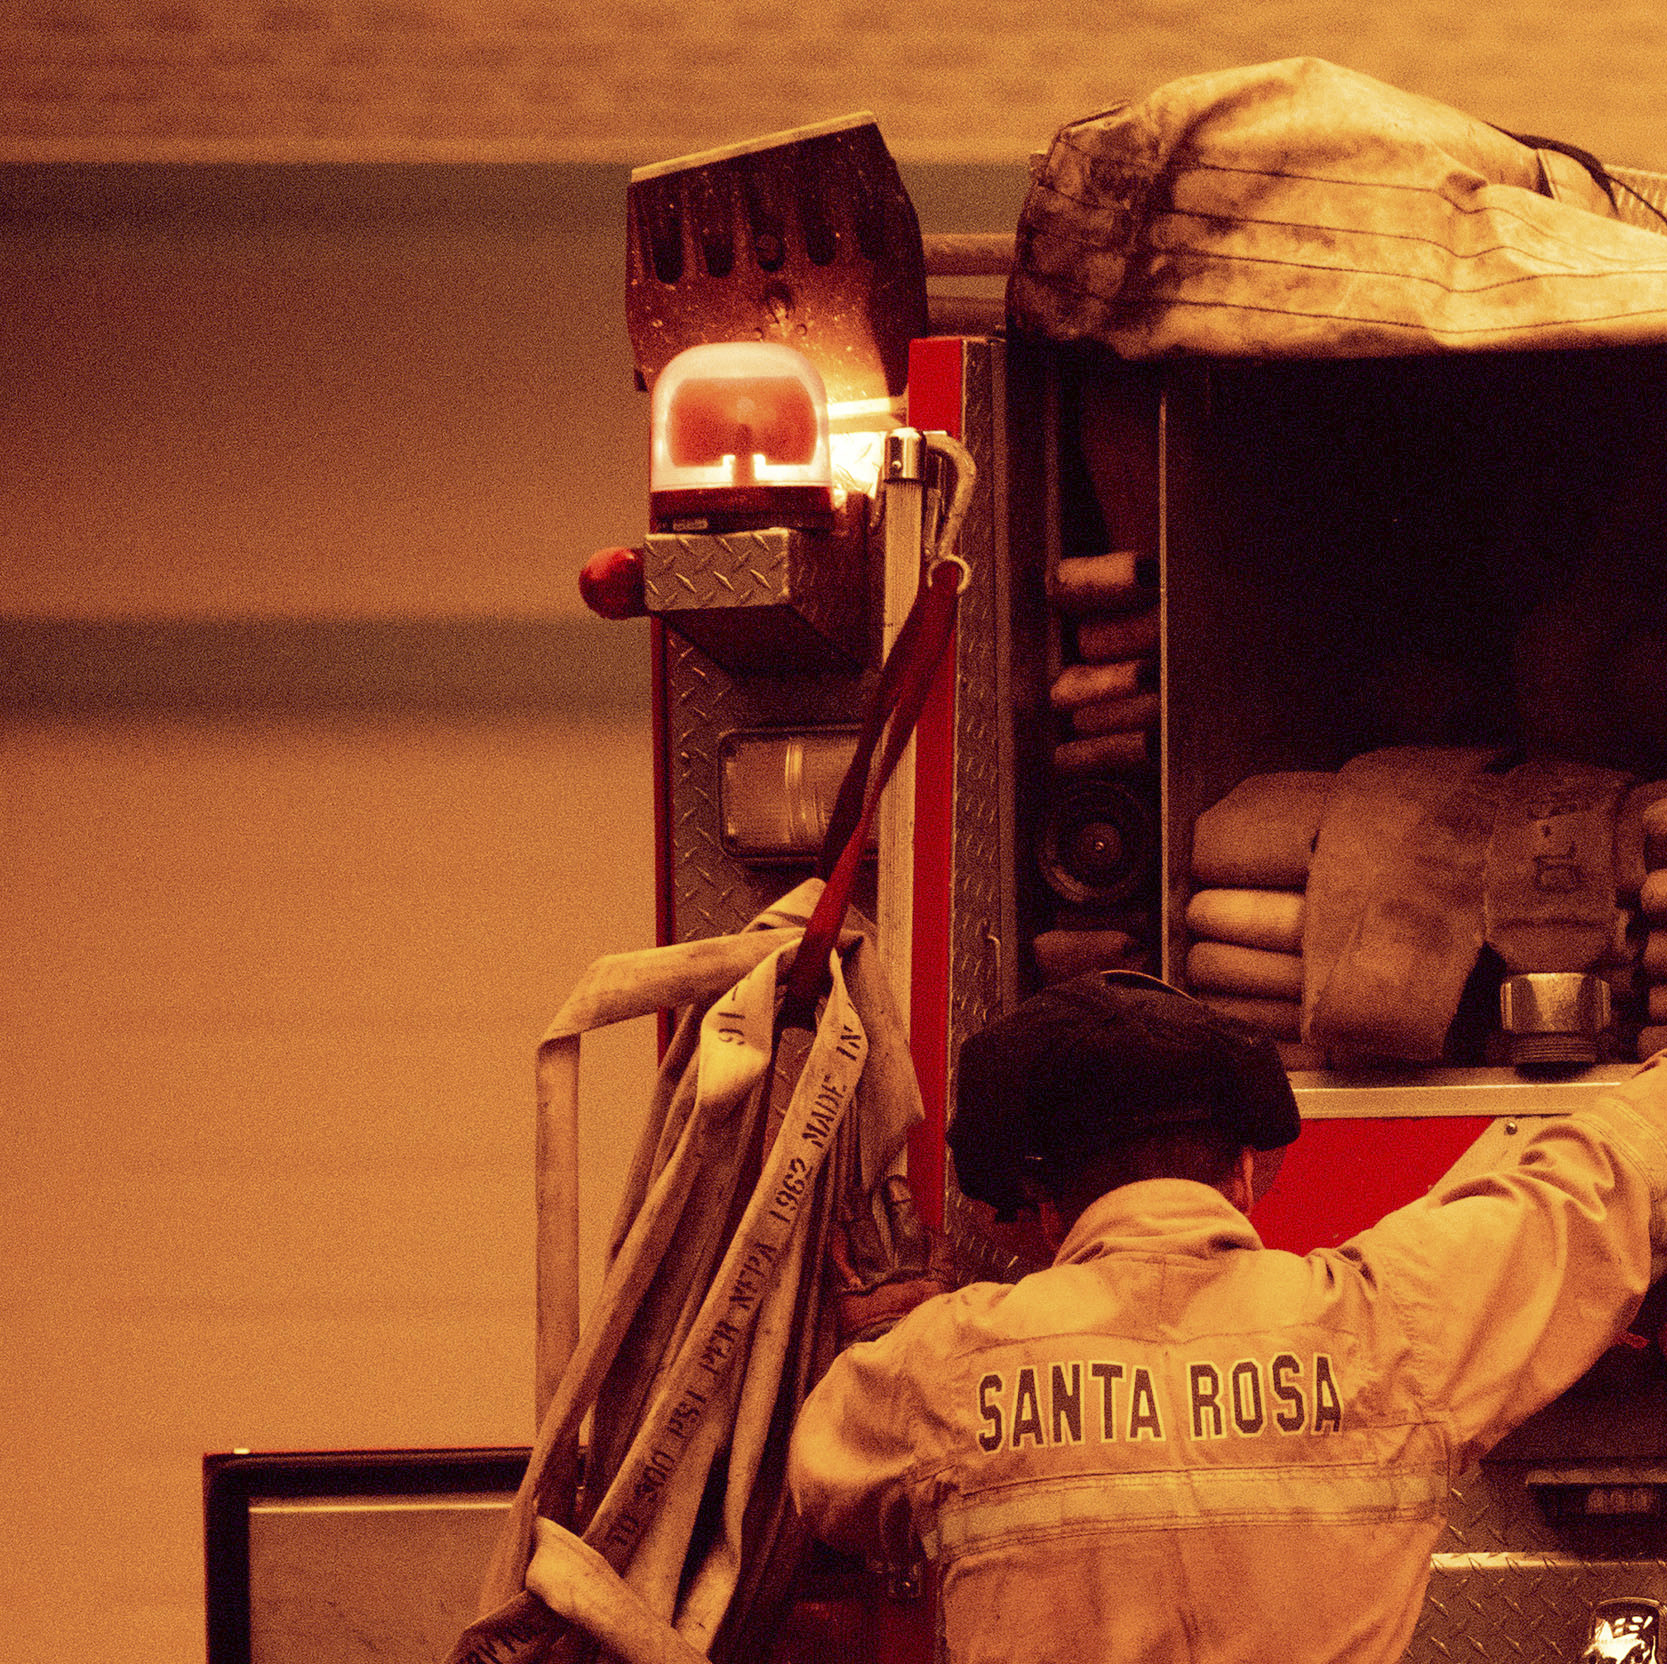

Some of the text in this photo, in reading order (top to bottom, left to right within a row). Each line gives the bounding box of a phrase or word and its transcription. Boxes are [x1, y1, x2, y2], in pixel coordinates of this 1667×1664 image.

[666, 1389, 707, 1440] PSI
[699, 1319, 740, 1376] PER
[729, 1241, 778, 1311] NFPA
[769, 1157, 814, 1224] 1962
[801, 1073, 848, 1149] MADE
[835, 1024, 863, 1062] IN
[975, 1351, 1344, 1454] SANTA ROSA
